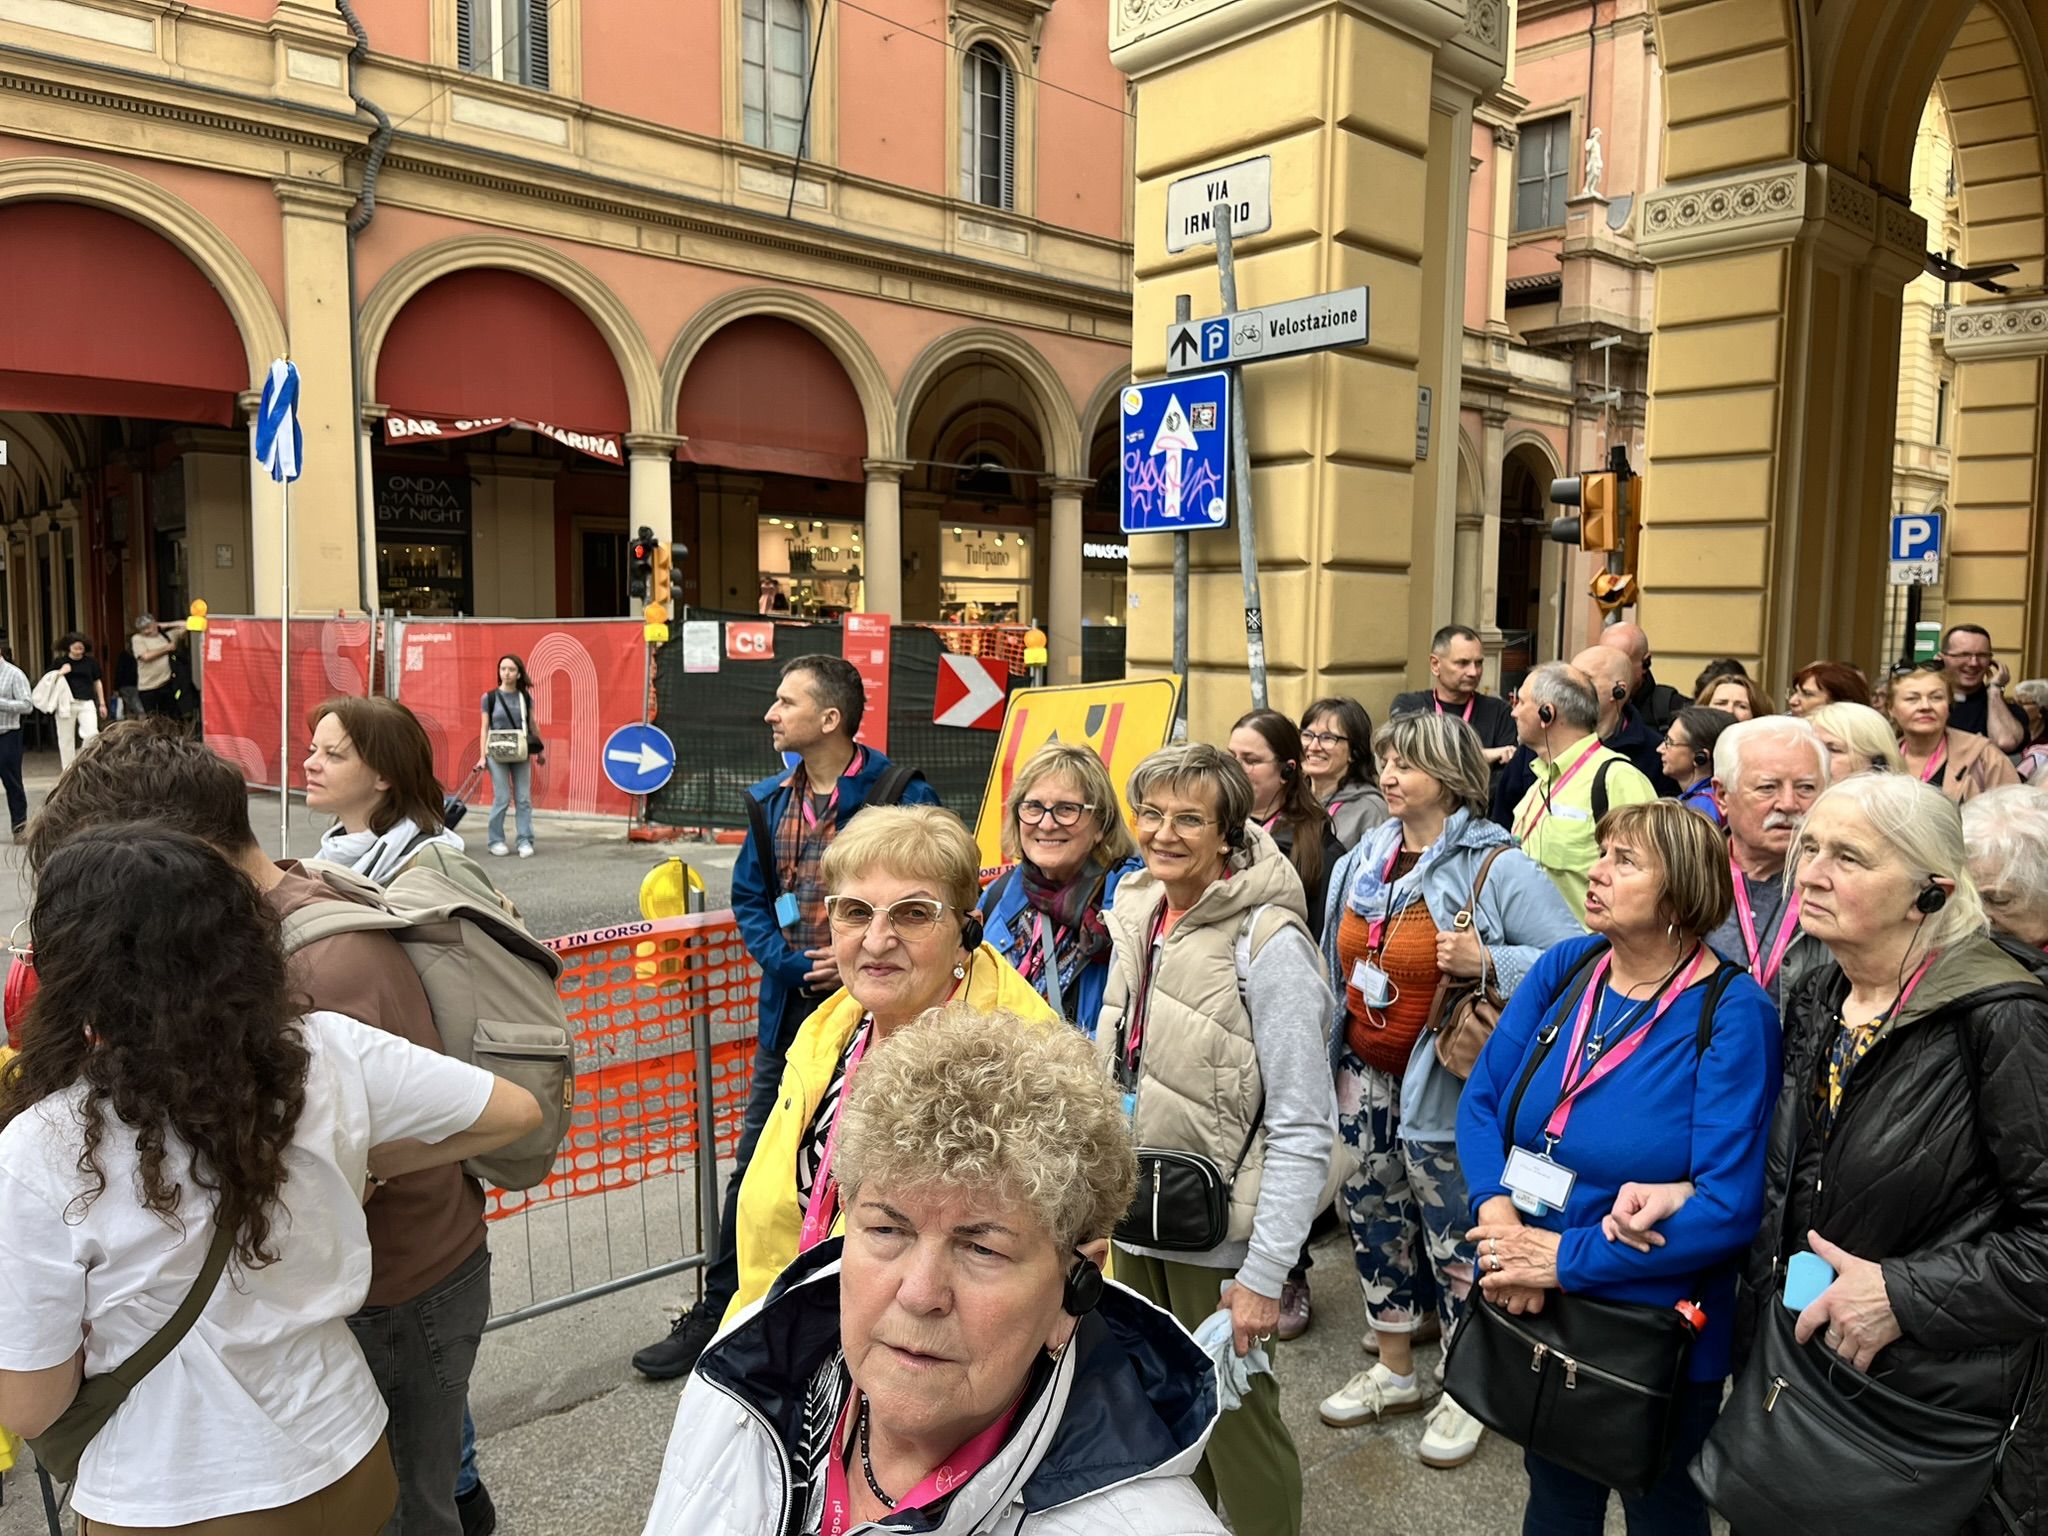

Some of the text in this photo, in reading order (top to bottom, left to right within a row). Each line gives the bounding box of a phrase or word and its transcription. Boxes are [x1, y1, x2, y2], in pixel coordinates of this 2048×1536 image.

[1207, 180, 1229, 202] VIA
[1185, 201, 1250, 236] IRNIO
[1269, 308, 1358, 338] Velostazione
[387, 417, 442, 438] BAR
[388, 475, 449, 492] ONDA
[381, 491, 459, 507] MARINA
[379, 505, 464, 523] BY NIGHT
[1899, 518, 1931, 558] P
[964, 543, 1010, 572] Tulipano
[735, 631, 766, 653] C8
[567, 933, 588, 947] IN
[593, 922, 653, 941] CORSO
